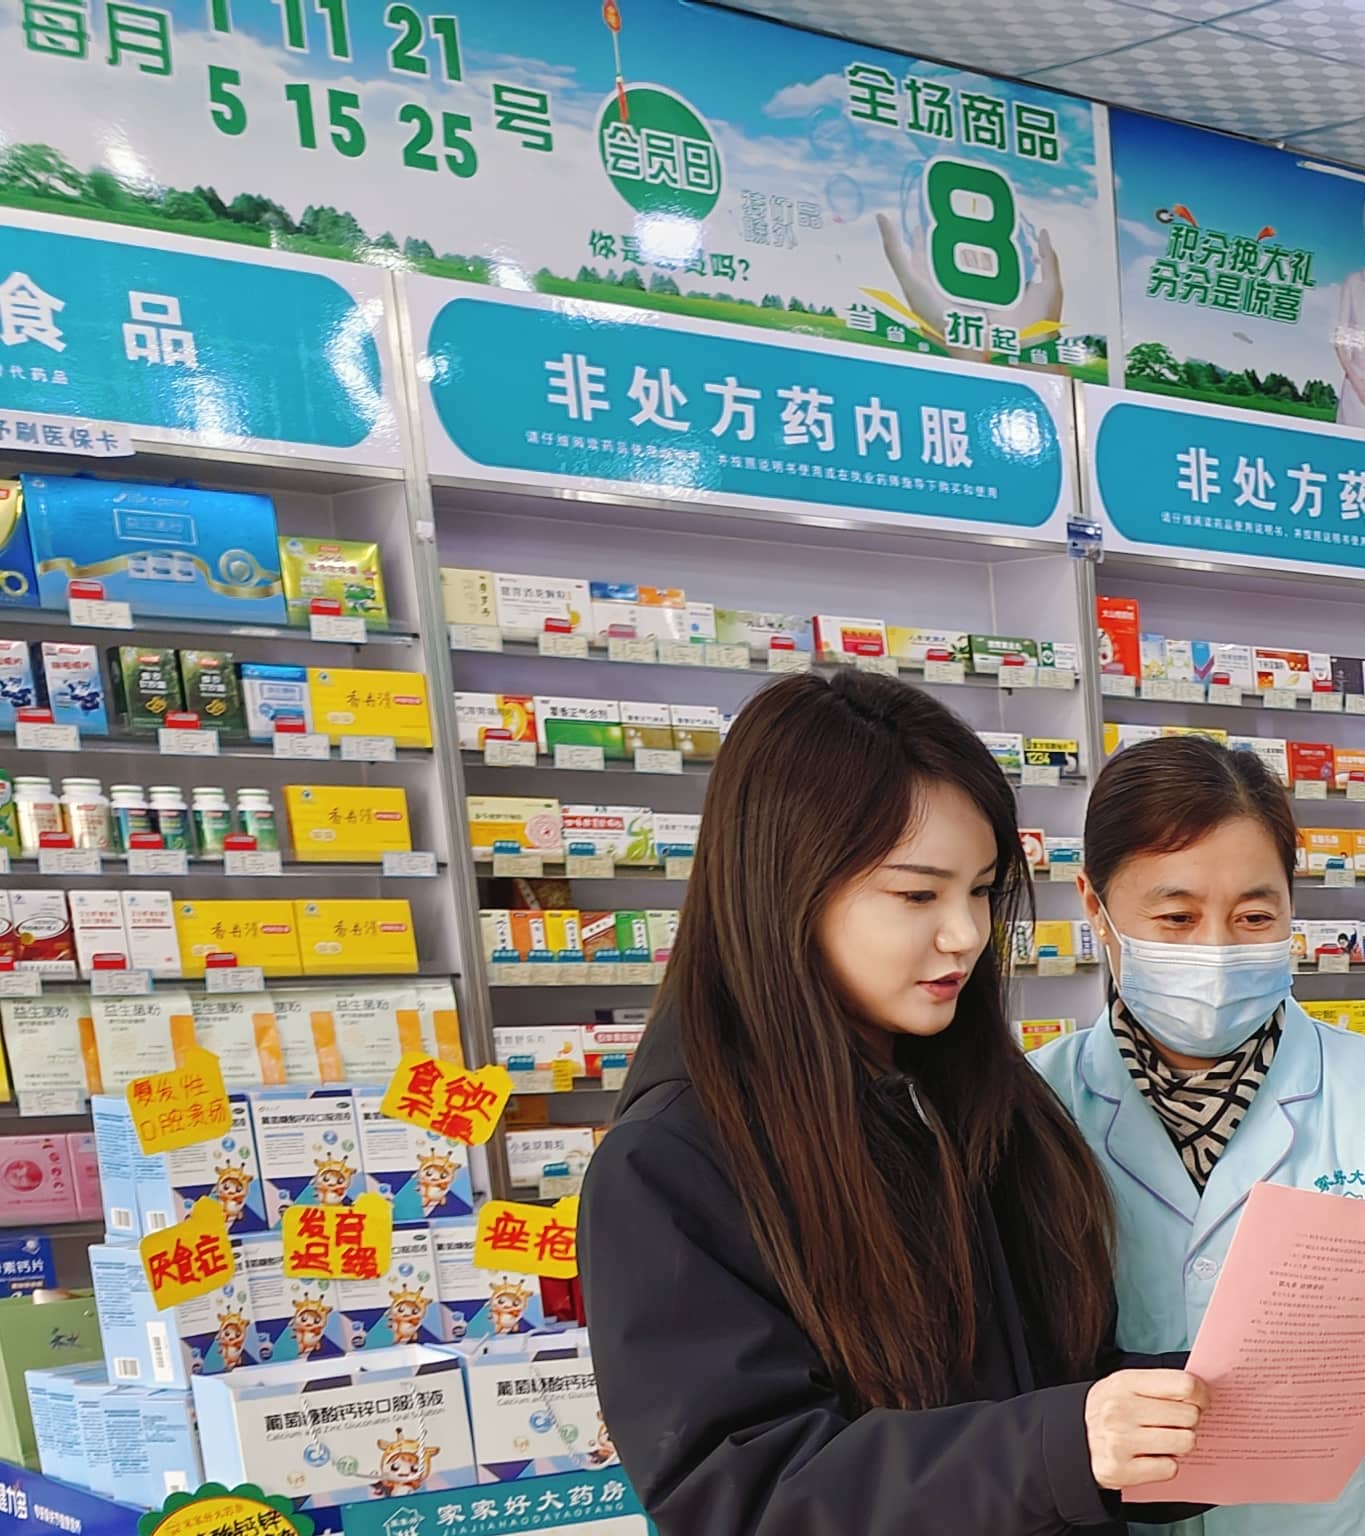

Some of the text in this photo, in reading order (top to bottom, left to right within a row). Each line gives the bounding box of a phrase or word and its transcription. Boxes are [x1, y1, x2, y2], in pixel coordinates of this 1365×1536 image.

[20, 0, 174, 78] 每月
[386, 2, 463, 82] 21
[209, 67, 479, 179] 5 15 25
[494, 84, 553, 152] 号
[845, 61, 1061, 163] 全场商品
[603, 123, 719, 194] 会员日
[927, 157, 1022, 308] 8
[1166, 225, 1316, 288] 积分换大礼
[0, 271, 199, 370] 食品
[1147, 257, 1304, 324] 分分是惊喜
[0, 363, 70, 385] 代药品
[545, 352, 974, 471] 非处方药内服
[149, 1232, 230, 1293] 厌食症
[297, 1206, 367, 1248] 发育
[436, 1478, 628, 1527] 家家好大药房
